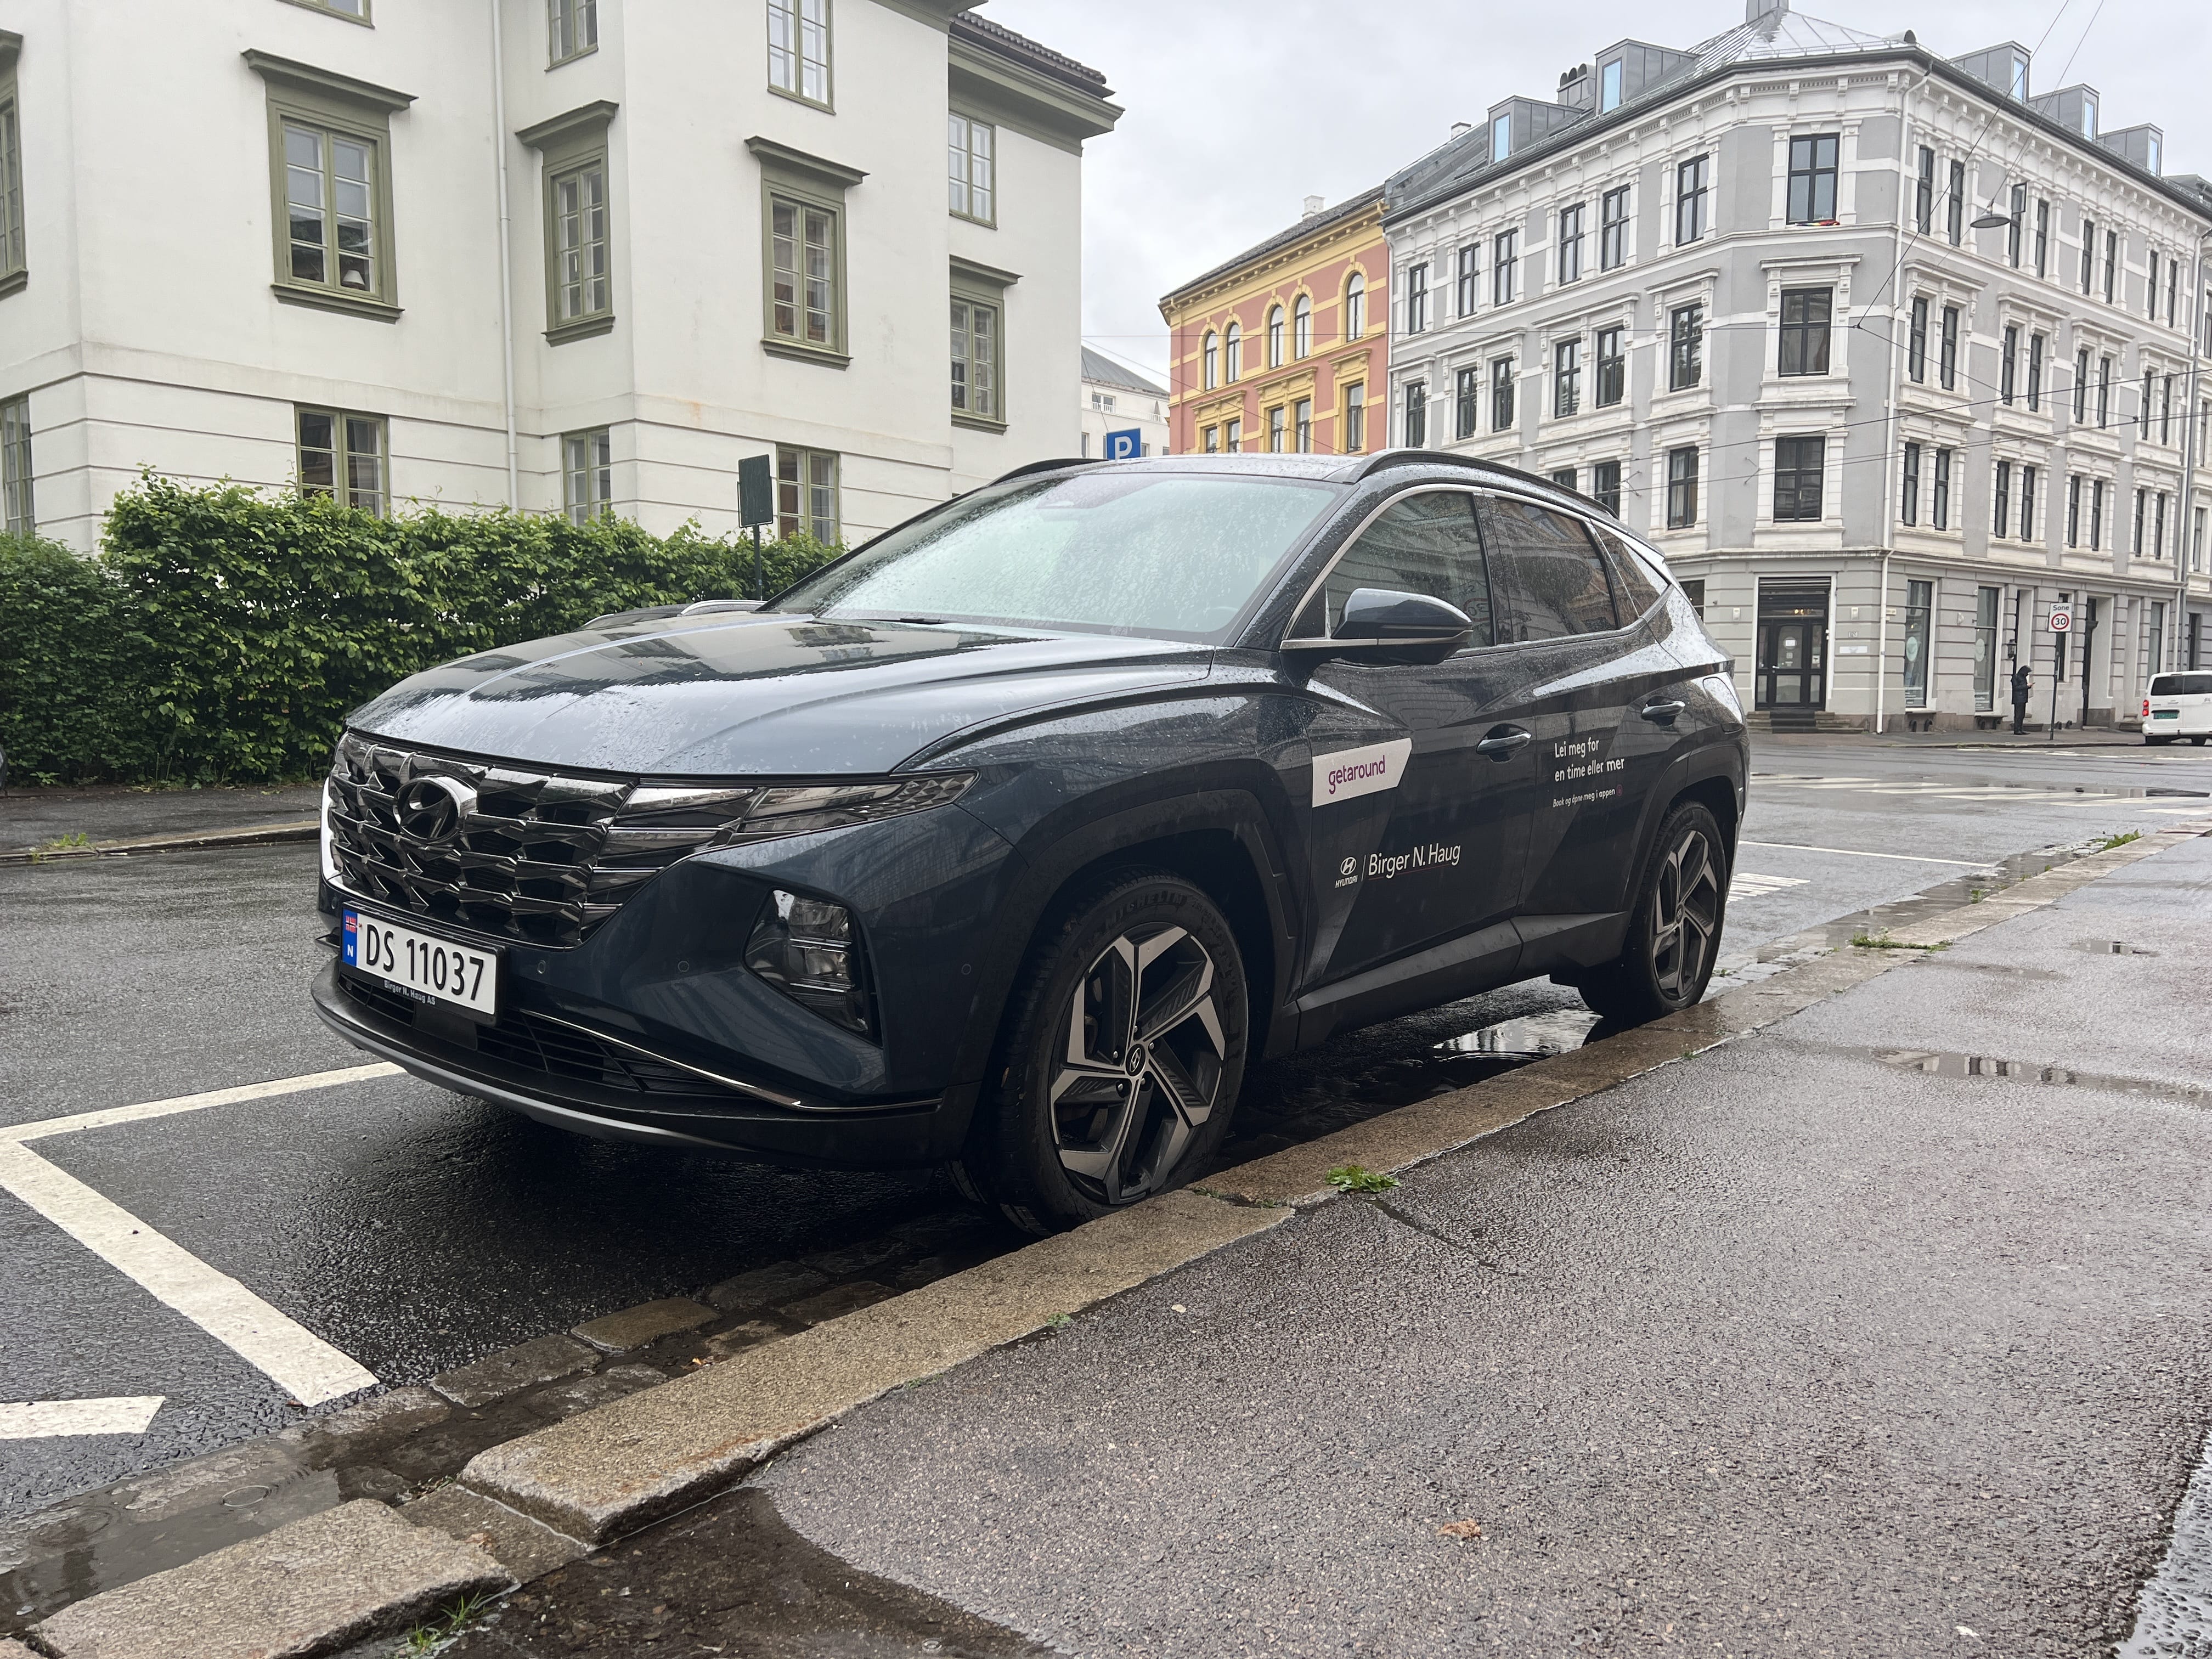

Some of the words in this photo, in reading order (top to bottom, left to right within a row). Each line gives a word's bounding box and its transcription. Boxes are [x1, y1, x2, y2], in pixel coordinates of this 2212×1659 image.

[1114, 436, 1132, 459] P
[1555, 741, 1566, 758] Lei
[1568, 742, 1586, 758] meg
[1588, 737, 1599, 752] for
[1328, 755, 1386, 794] getaround
[1555, 769, 1565, 782] en
[1567, 764, 1585, 780] time
[1587, 759, 1604, 775] eller
[1606, 758, 1625, 772] mer
[1553, 798, 1565, 808] Book
[1565, 798, 1572, 807] og
[1583, 793, 1595, 802] meg
[1595, 789, 1598, 798] i
[1599, 788, 1616, 800] appen
[1368, 852, 1410, 879] Birger
[1413, 845, 1426, 867] N.
[1428, 843, 1461, 866] Haug
[1335, 875, 1358, 889] HYUNDAI
[347, 944, 353, 957] N
[366, 924, 394, 972] DS
[407, 938, 484, 1001] 11037
[384, 980, 402, 992] Birger
[403, 986, 409, 996] N.
[410, 989, 426, 1003] Haug
[427, 995, 436, 1005] AS
